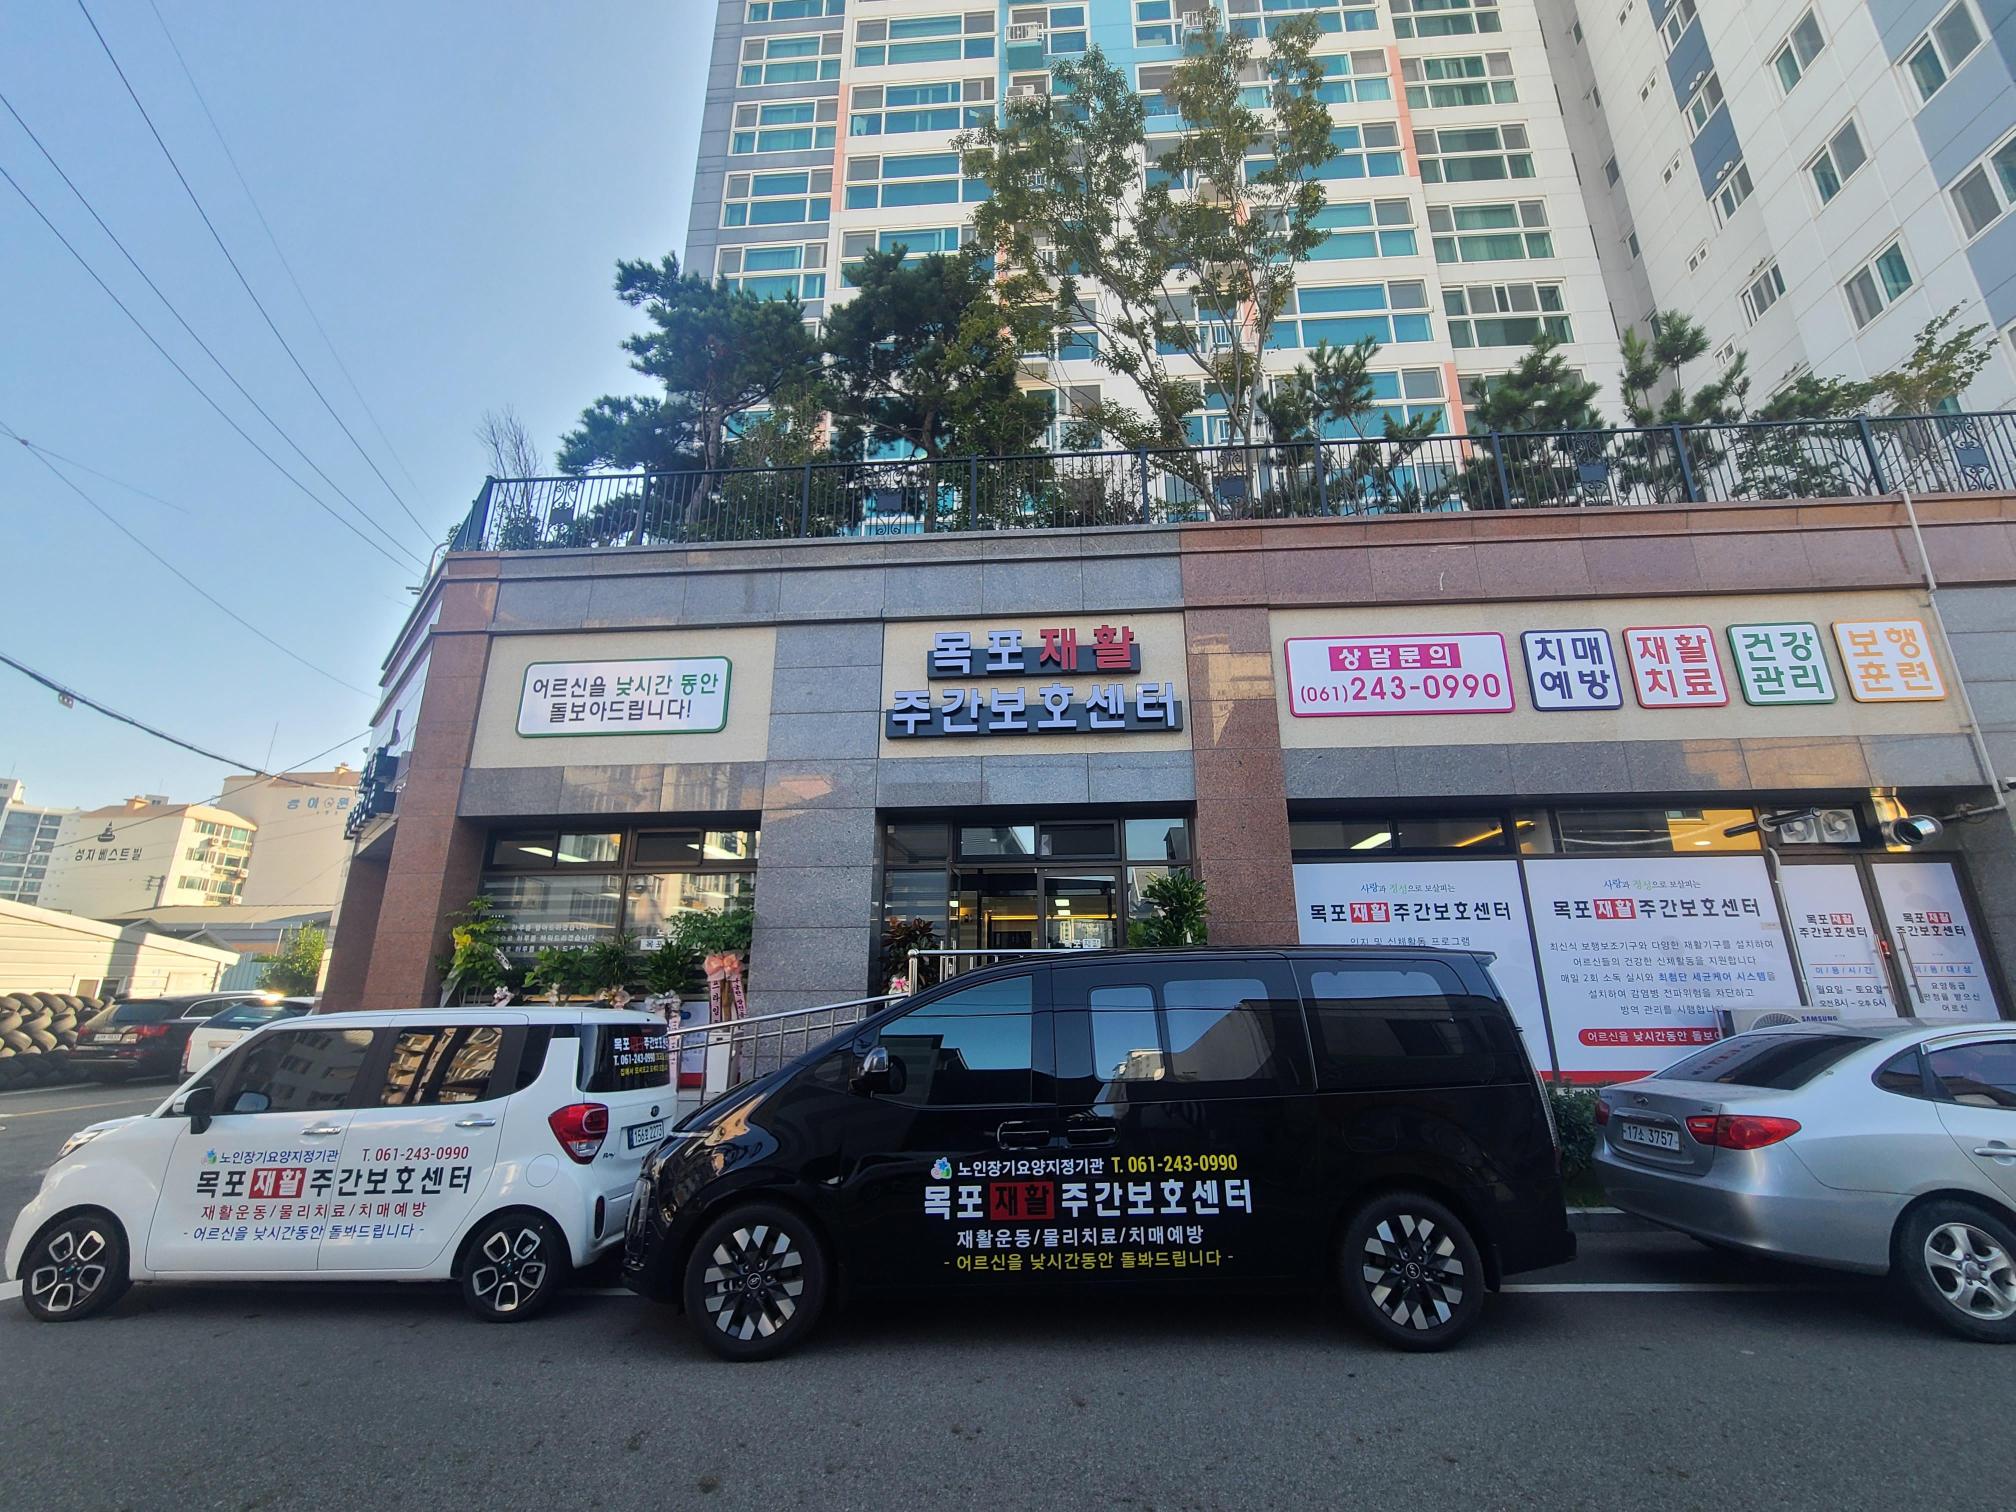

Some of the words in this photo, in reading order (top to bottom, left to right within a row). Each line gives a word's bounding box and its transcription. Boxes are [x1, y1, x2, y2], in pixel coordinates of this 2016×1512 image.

[1535, 637, 1604, 666] 치매
[1637, 635, 1708, 665] 재활
[1742, 631, 1813, 662] 건강
[1848, 628, 1921, 659] 보행
[1339, 646, 1451, 670] 상담문의
[533, 676, 606, 699] 어르신을
[616, 675, 672, 696] 낮시간
[681, 673, 718, 695] 동안
[1540, 670, 1610, 700] 예방
[1645, 668, 1717, 698] 치료
[1751, 665, 1824, 696] 관리
[1856, 661, 1937, 693] 훈련
[1301, 674, 1500, 704] (061)243-0990
[550, 700, 691, 723] 돌보아드립니다!
[892, 683, 1175, 734] 주간보호센터
[1360, 882, 1387, 893] 사랑과
[1425, 883, 1456, 893] 보살피는
[1604, 879, 1630, 890] 사랑과
[1669, 880, 1701, 890] 보살피는
[1311, 904, 1347, 923] 목포
[1353, 903, 1389, 922] 재활
[1393, 901, 1511, 922] 주간보호센터
[1554, 901, 1592, 920] 목포
[1597, 899, 1632, 918] 재활
[1639, 897, 1761, 919] 주간보호센터
[1807, 914, 1829, 925] 목포
[1903, 912, 1925, 923] 목포
[1431, 936, 1470, 947] 프로그램
[1799, 926, 1867, 938] 주간보호센터
[1896, 925, 1966, 936] 주간보호센터
[1550, 942, 1577, 951] 최신식
[1582, 941, 1647, 951] 보행보조기구와
[1651, 940, 1679, 950] 다양한
[1684, 940, 1731, 950] 재활기구를
[1573, 957, 1620, 967] 어르신들의
[1624, 957, 1652, 966] 건강한
[1657, 956, 1704, 966] 신체활동을
[1709, 956, 1756, 966] 지원합니다
[1560, 973, 1579, 983] 매일
[1583, 973, 1599, 982] 2회
[1603, 973, 1621, 982] 소독
[1626, 973, 1654, 982] 실시와
[1659, 972, 1687, 982] 최첨단
[1693, 972, 1732, 981] 세균케어
[1588, 989, 1626, 999] 설치하여
[1631, 989, 1659, 998] 감염병
[1664, 988, 1711, 998] 전파위험을
[1716, 988, 1756, 997] 차단하고
[1816, 985, 1843, 994] 월요일
[1856, 985, 1883, 994] 토요일
[1621, 1005, 1639, 1015] 방역
[1643, 1005, 1671, 1015] 관리를
[1801, 1015, 1838, 1023] SAMSUNG
[1588, 1032, 1629, 1043] 어르신을
[1633, 1031, 1687, 1042] 낮시간동안
[1649, 1126, 1673, 1146] 3757
[219, 1149, 340, 1165] 노인장기요양지정기관
[375, 1146, 469, 1161] 061-243-0990
[957, 1158, 1104, 1176] 노인장기요양지정기관
[1111, 1156, 1123, 1173] T.
[1128, 1154, 1238, 1173] 061-243-0990
[197, 1170, 247, 1199] 목포
[254, 1168, 303, 1197] 재활
[310, 1166, 473, 1197] 주간보호센터
[924, 1185, 984, 1220] 목포
[994, 1183, 1050, 1217] 재활
[1061, 1179, 1252, 1218] 주간보호센터
[201, 1202, 427, 1220] 재활운동/물리치료/치매예방
[193, 1226, 248, 1241] 어르신을
[253, 1225, 323, 1241] 낮시간동안
[329, 1223, 414, 1239] 돌봐드립니다
[957, 1225, 1204, 1249] 재활운동/물리치료/치매예방
[957, 1253, 1023, 1271] 어르신을
[1030, 1251, 1114, 1270] 낮시간동안
[1120, 1249, 1221, 1268] 돌봐드립니다
